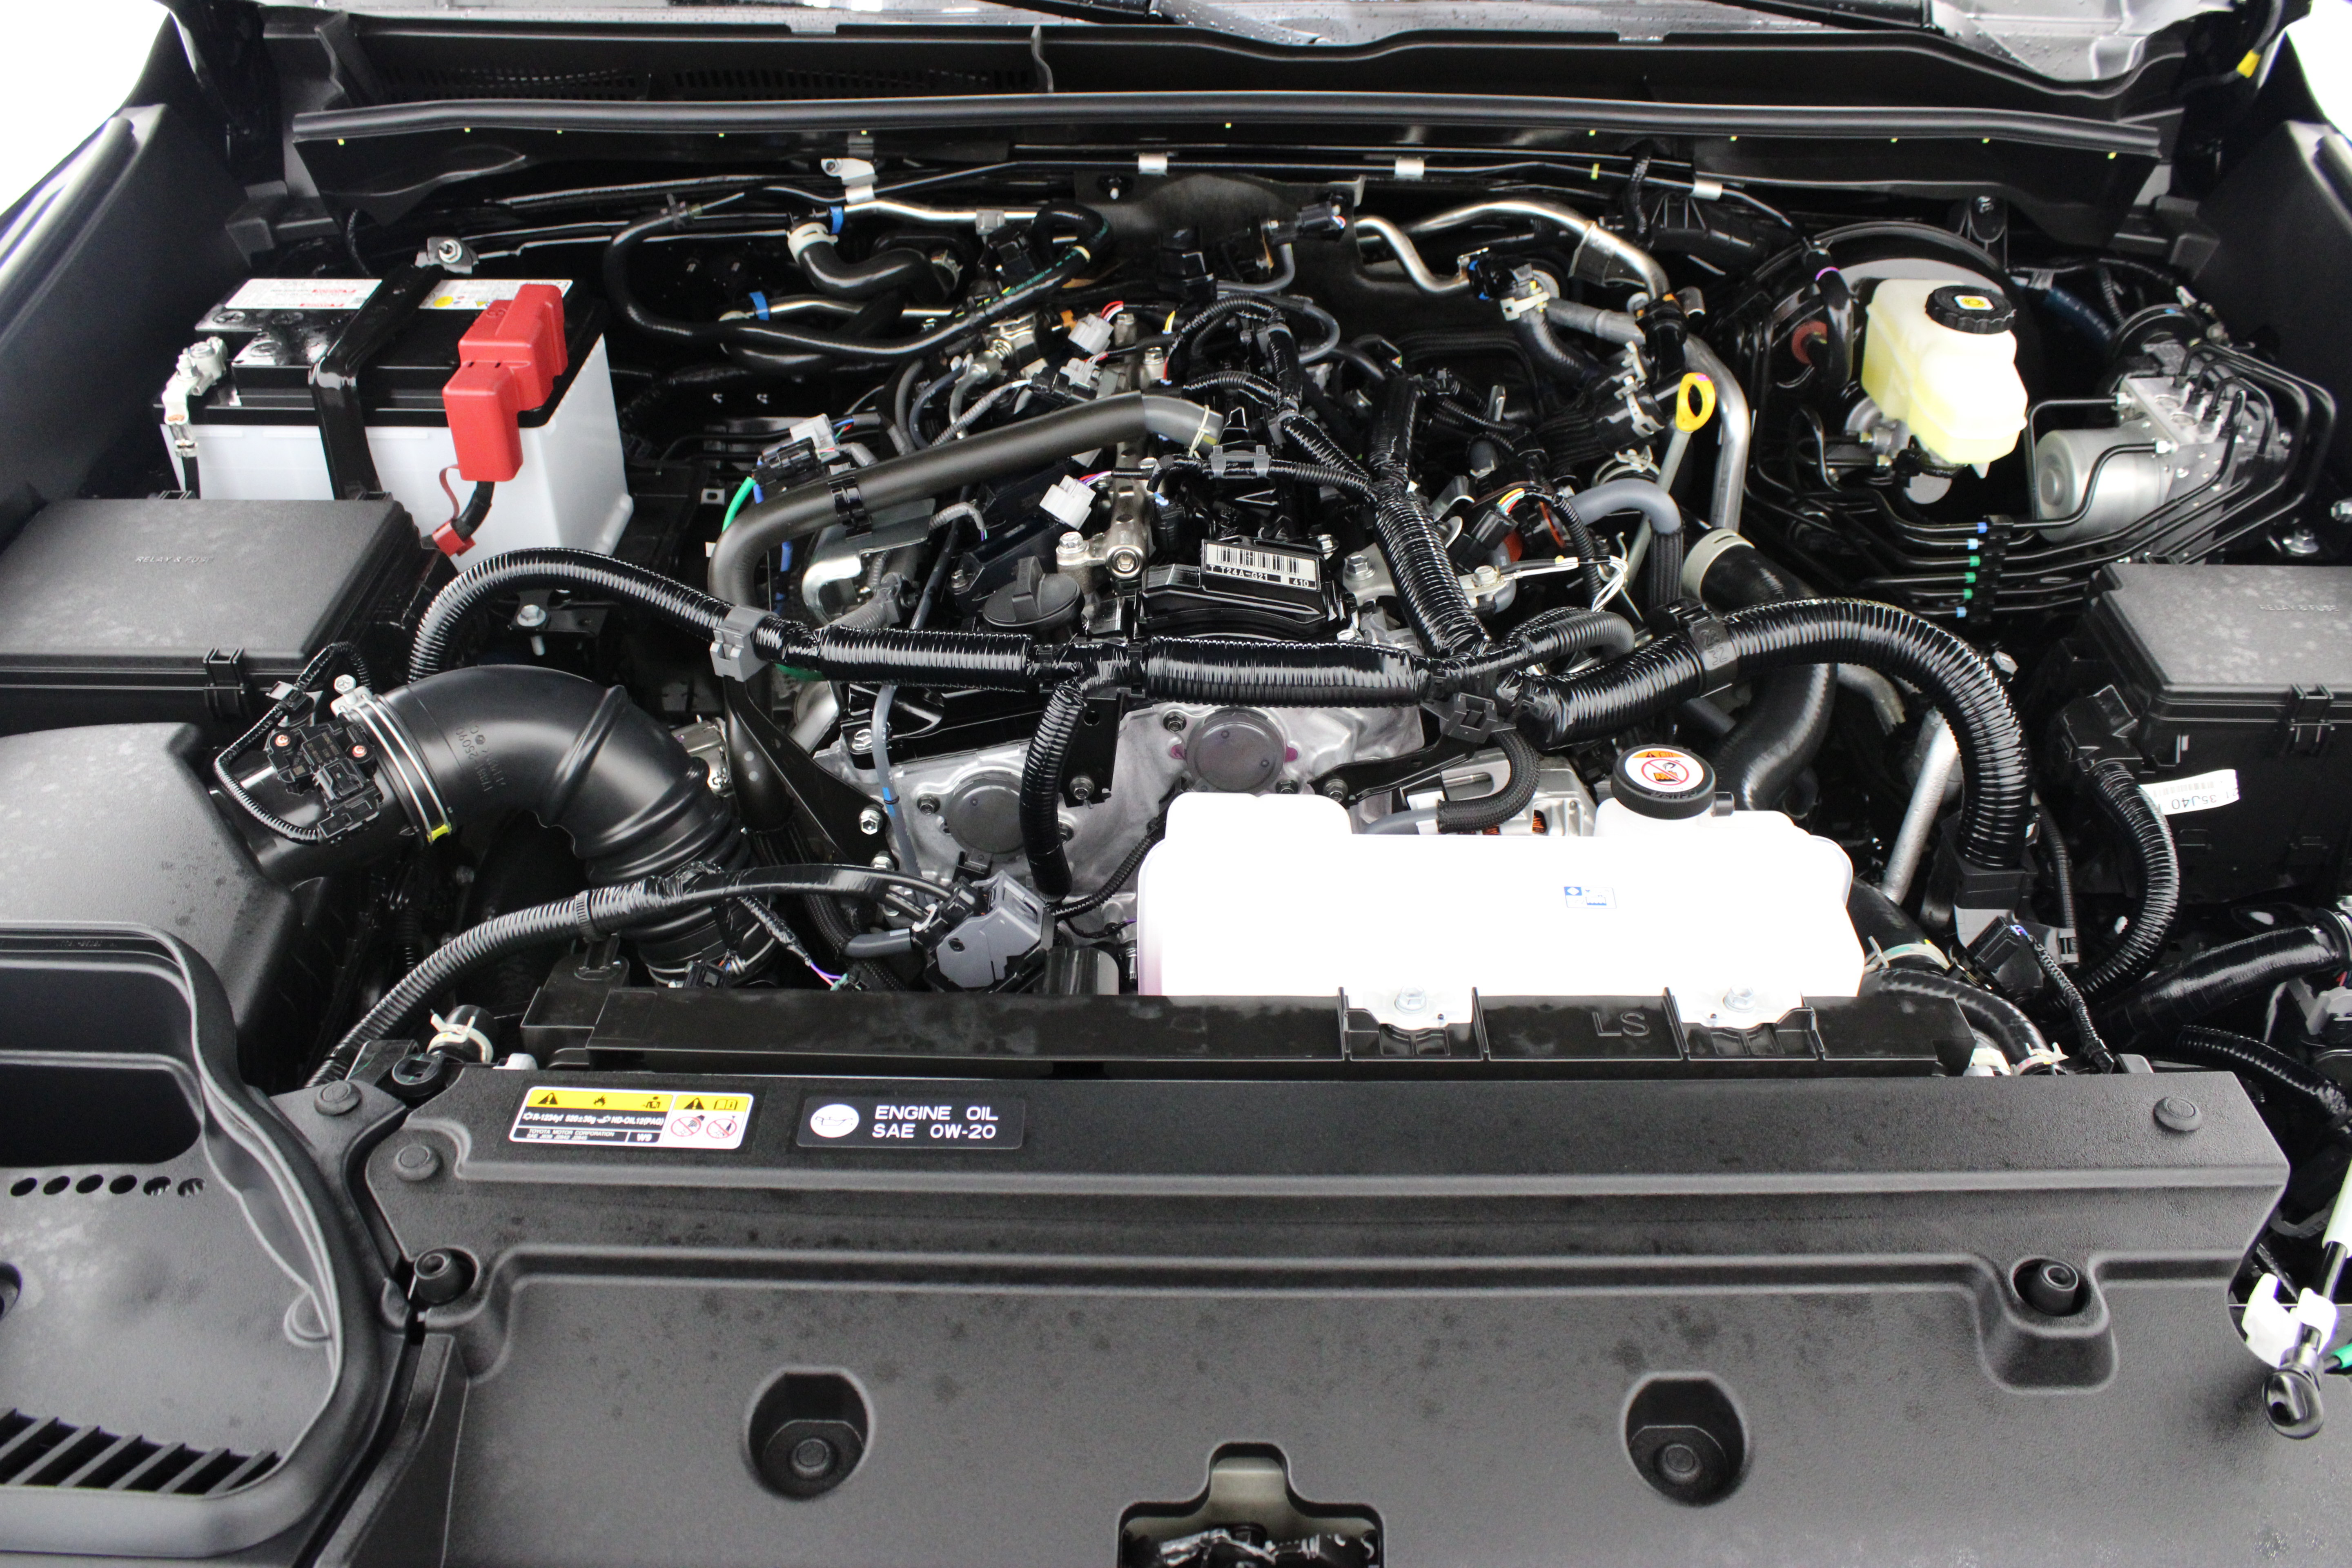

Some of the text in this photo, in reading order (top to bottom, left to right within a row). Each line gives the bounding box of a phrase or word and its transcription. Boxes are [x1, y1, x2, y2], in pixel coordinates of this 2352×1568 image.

[1220, 566, 1268, 581] T24A-G21
[1708, 644, 1728, 666] 32
[2171, 794, 2217, 810] 35J40
[1592, 1011, 1650, 1037] LS
[532, 1113, 564, 1123] R-1234yf
[565, 1114, 597, 1125] 520±30g
[875, 1105, 999, 1121] ENGINE OIL
[636, 1133, 653, 1142] W9
[872, 1123, 996, 1139] SAE 0W-20
